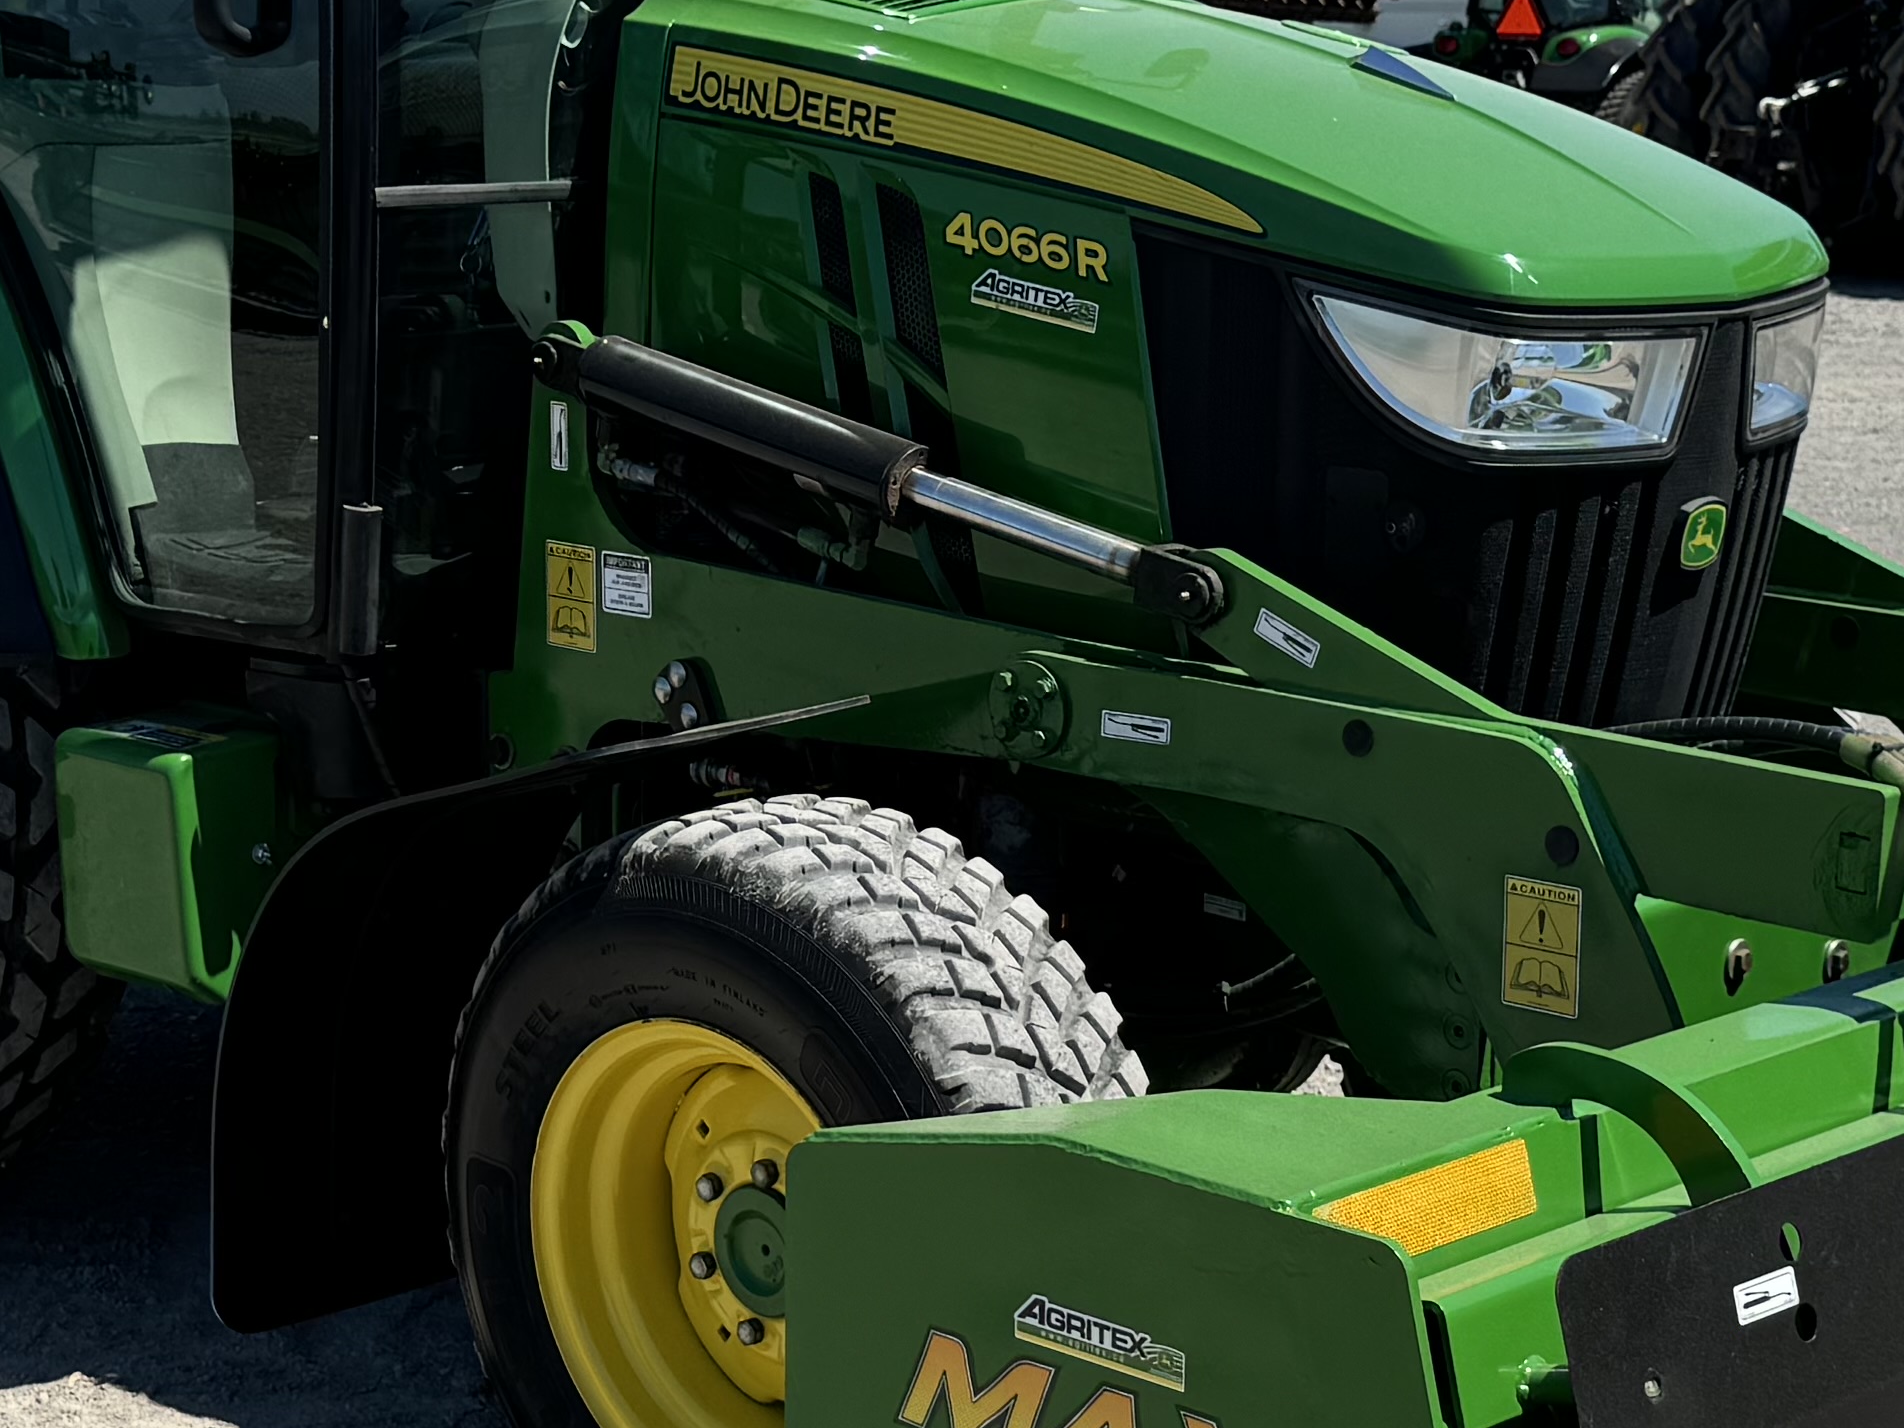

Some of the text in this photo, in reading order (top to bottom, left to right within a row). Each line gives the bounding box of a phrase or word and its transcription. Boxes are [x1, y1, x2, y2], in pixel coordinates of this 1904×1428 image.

[680, 60, 897, 141] JOHN DEERE
[975, 271, 1072, 311] AGRITEX
[1520, 883, 1576, 903] CAUTION
[1017, 1297, 1149, 1359] AGRITEX
